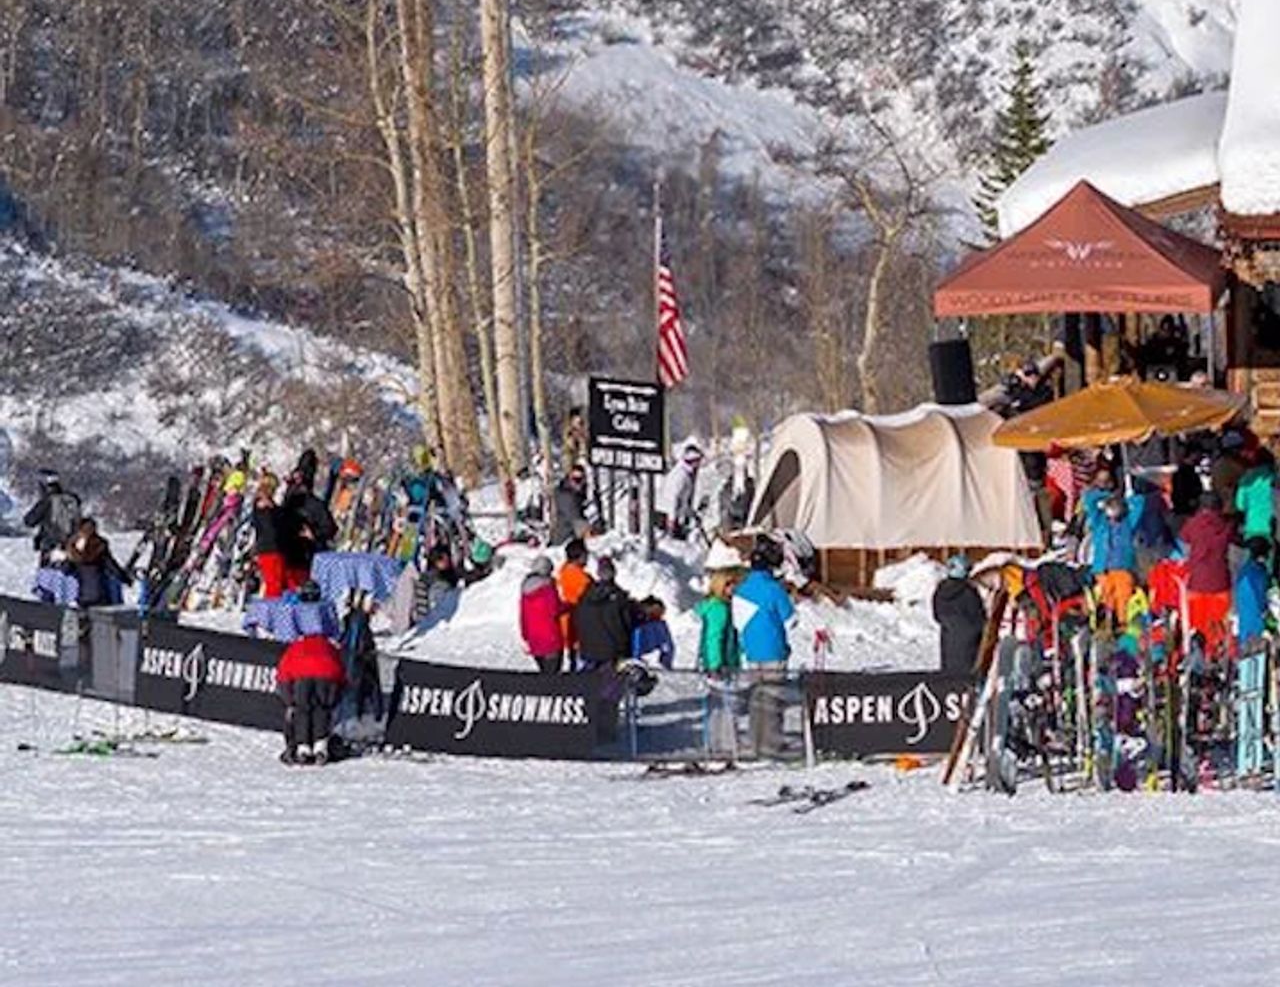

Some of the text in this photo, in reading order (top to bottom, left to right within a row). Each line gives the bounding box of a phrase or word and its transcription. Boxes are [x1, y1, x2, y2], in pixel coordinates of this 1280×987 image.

[140, 646, 183, 679] ASPEN
[486, 692, 590, 725] SNOWMASS.
[813, 695, 895, 725] ASPEN
